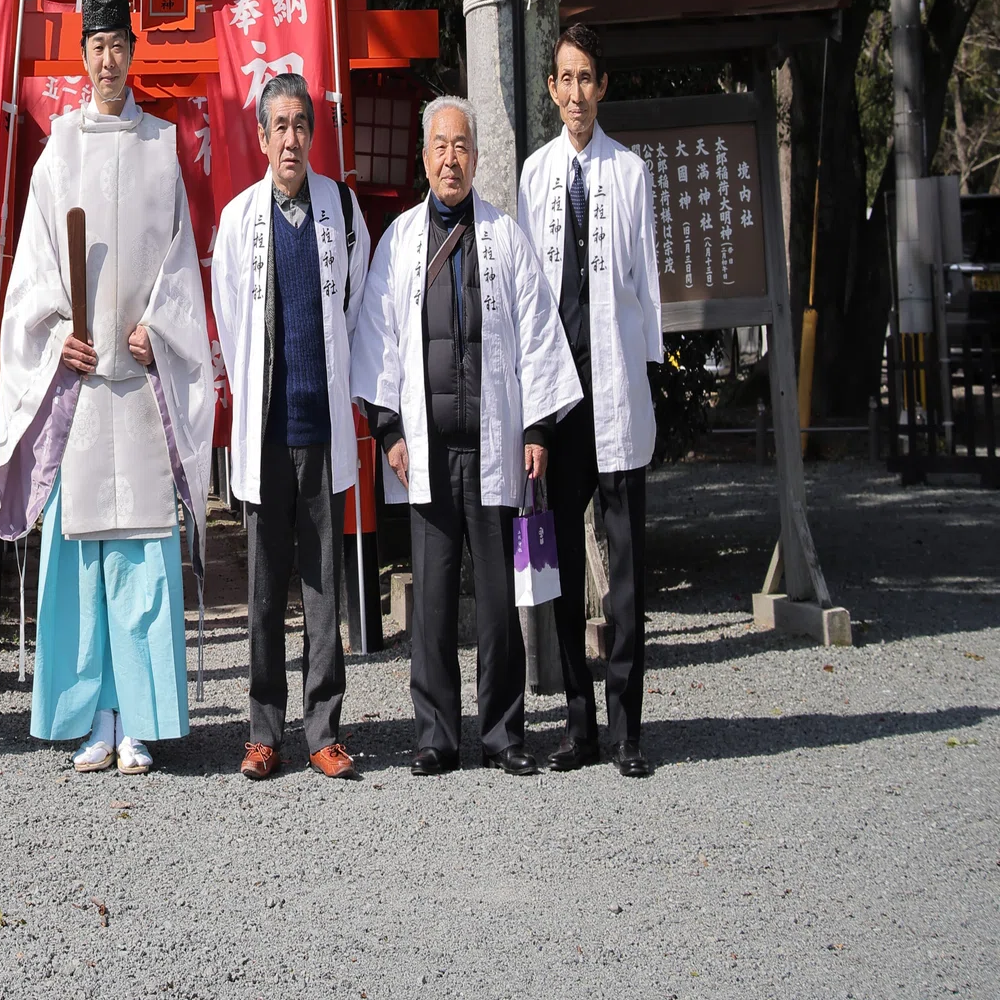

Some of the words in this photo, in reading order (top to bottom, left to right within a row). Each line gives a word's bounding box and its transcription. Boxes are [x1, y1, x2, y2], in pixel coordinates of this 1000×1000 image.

[714, 136, 733, 240] 太郎稲荷大明神
[737, 161, 754, 229] 境内社
